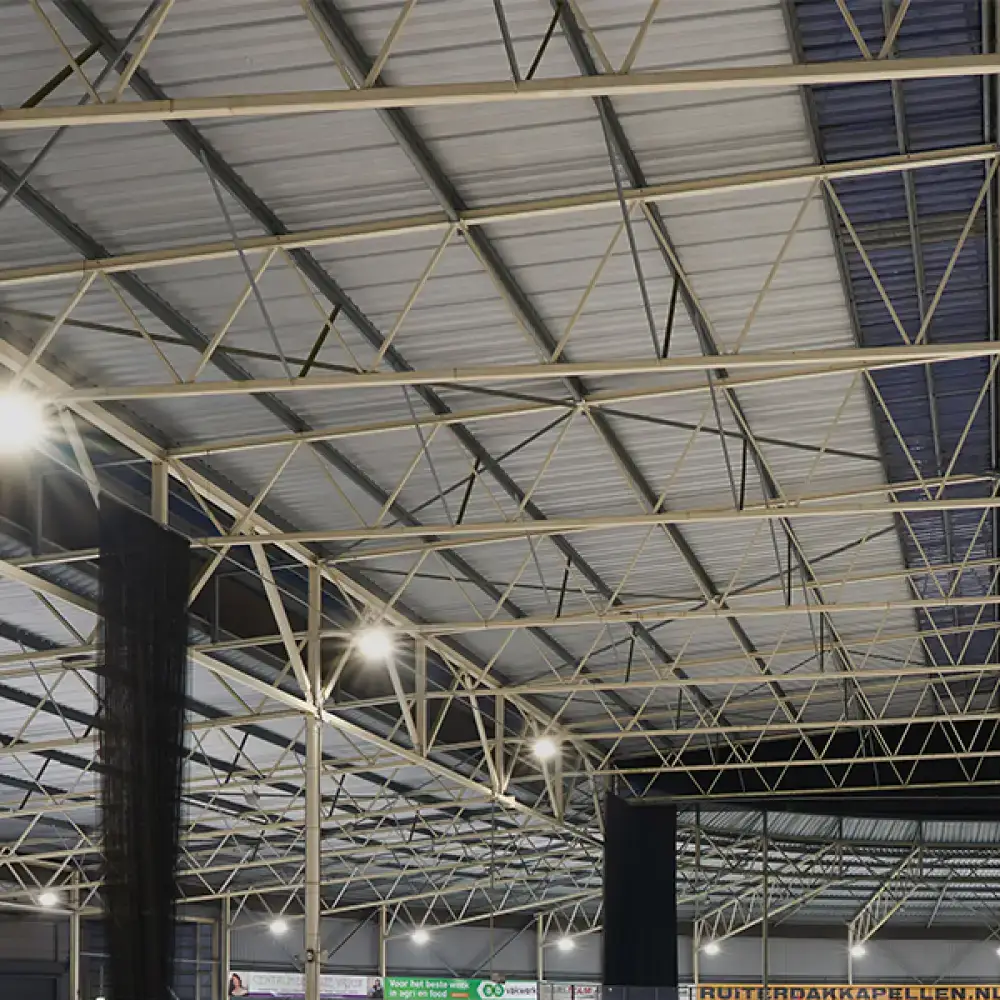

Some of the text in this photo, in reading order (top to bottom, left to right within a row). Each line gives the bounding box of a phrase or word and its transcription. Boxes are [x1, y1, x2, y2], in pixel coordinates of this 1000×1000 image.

[389, 979, 409, 988] Voor
[410, 979, 424, 988] het
[426, 980, 448, 989] beste
[399, 989, 415, 999] agri
[429, 989, 448, 998] food
